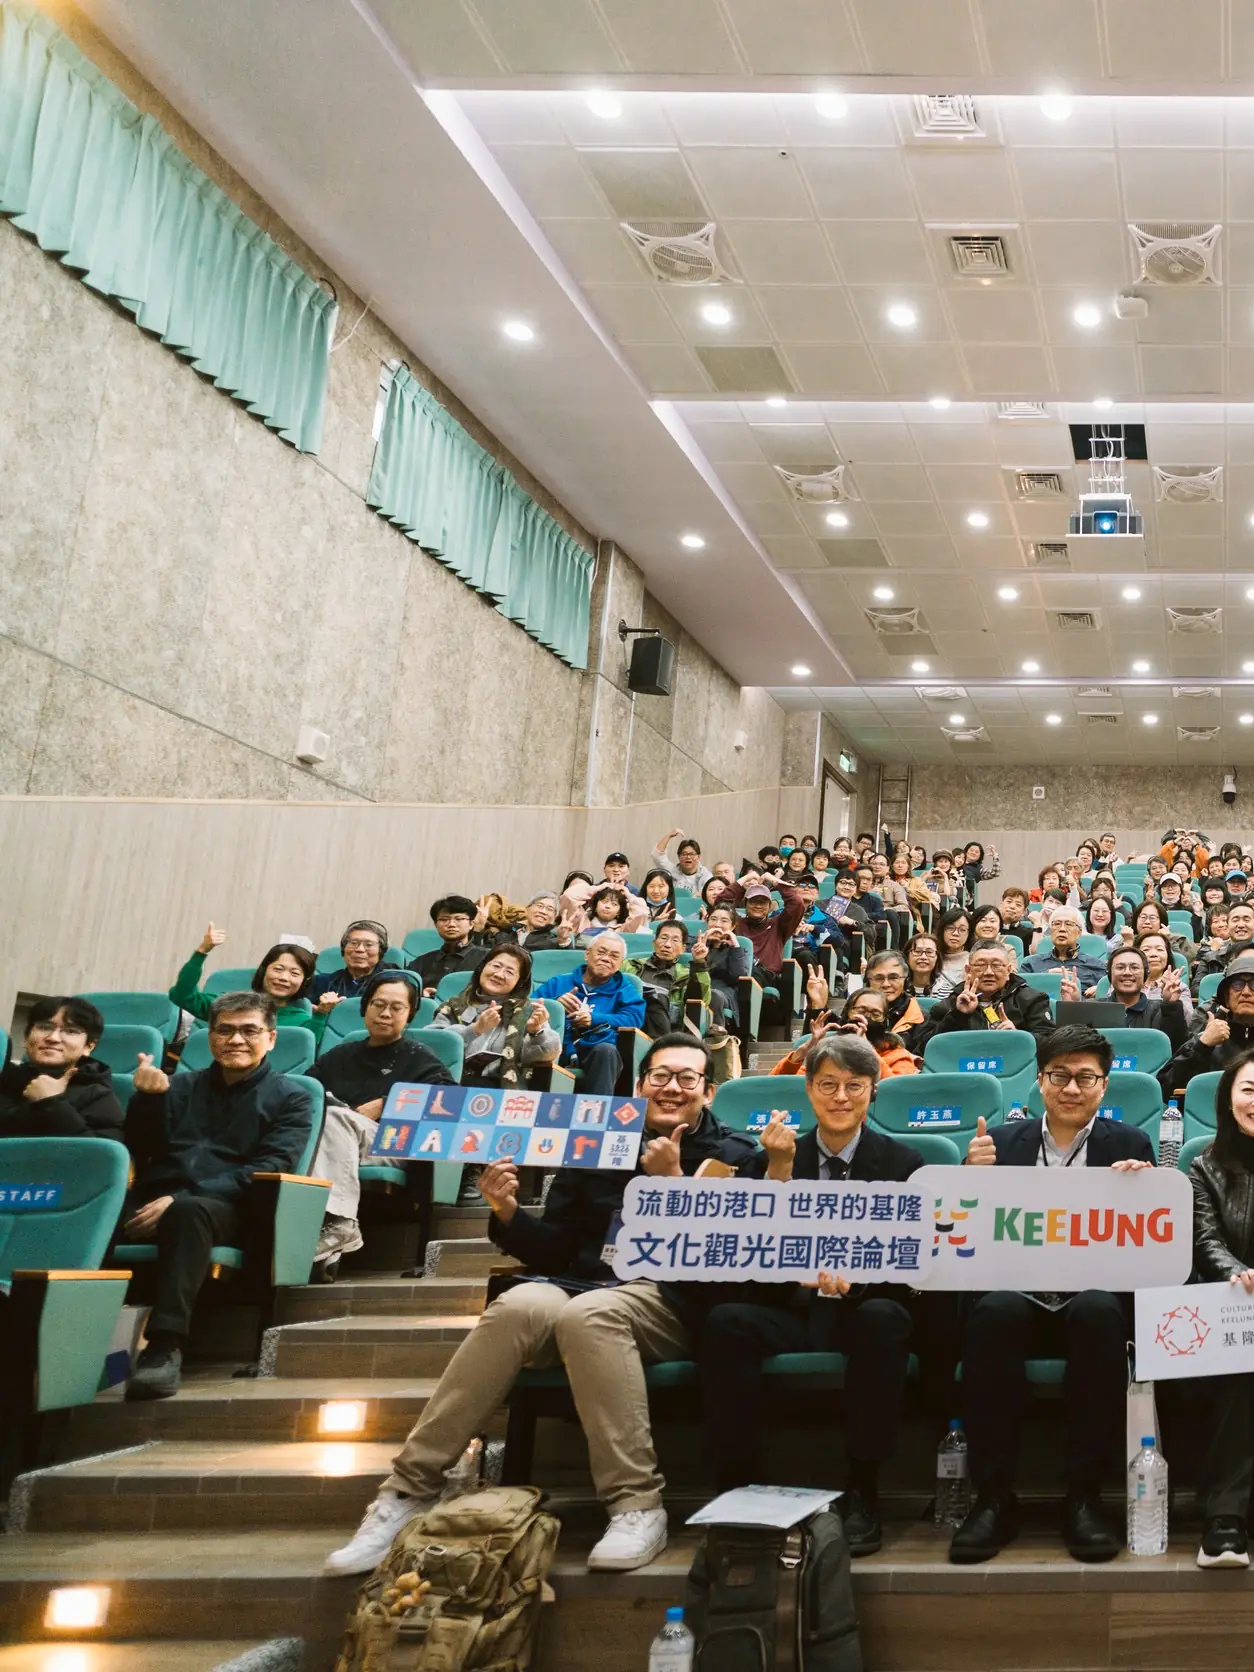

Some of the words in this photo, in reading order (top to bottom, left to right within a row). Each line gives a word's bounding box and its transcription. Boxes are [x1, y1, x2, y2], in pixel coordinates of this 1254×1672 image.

[966, 1060, 997, 1071] 保留席
[1112, 1059, 1132, 1069] 留席
[635, 1189, 777, 1219] 流動的港口
[788, 1191, 923, 1223] 世界的基隆
[993, 1207, 1174, 1247] KEELUNG
[626, 1231, 922, 1270] 文化觀光國際論壇
